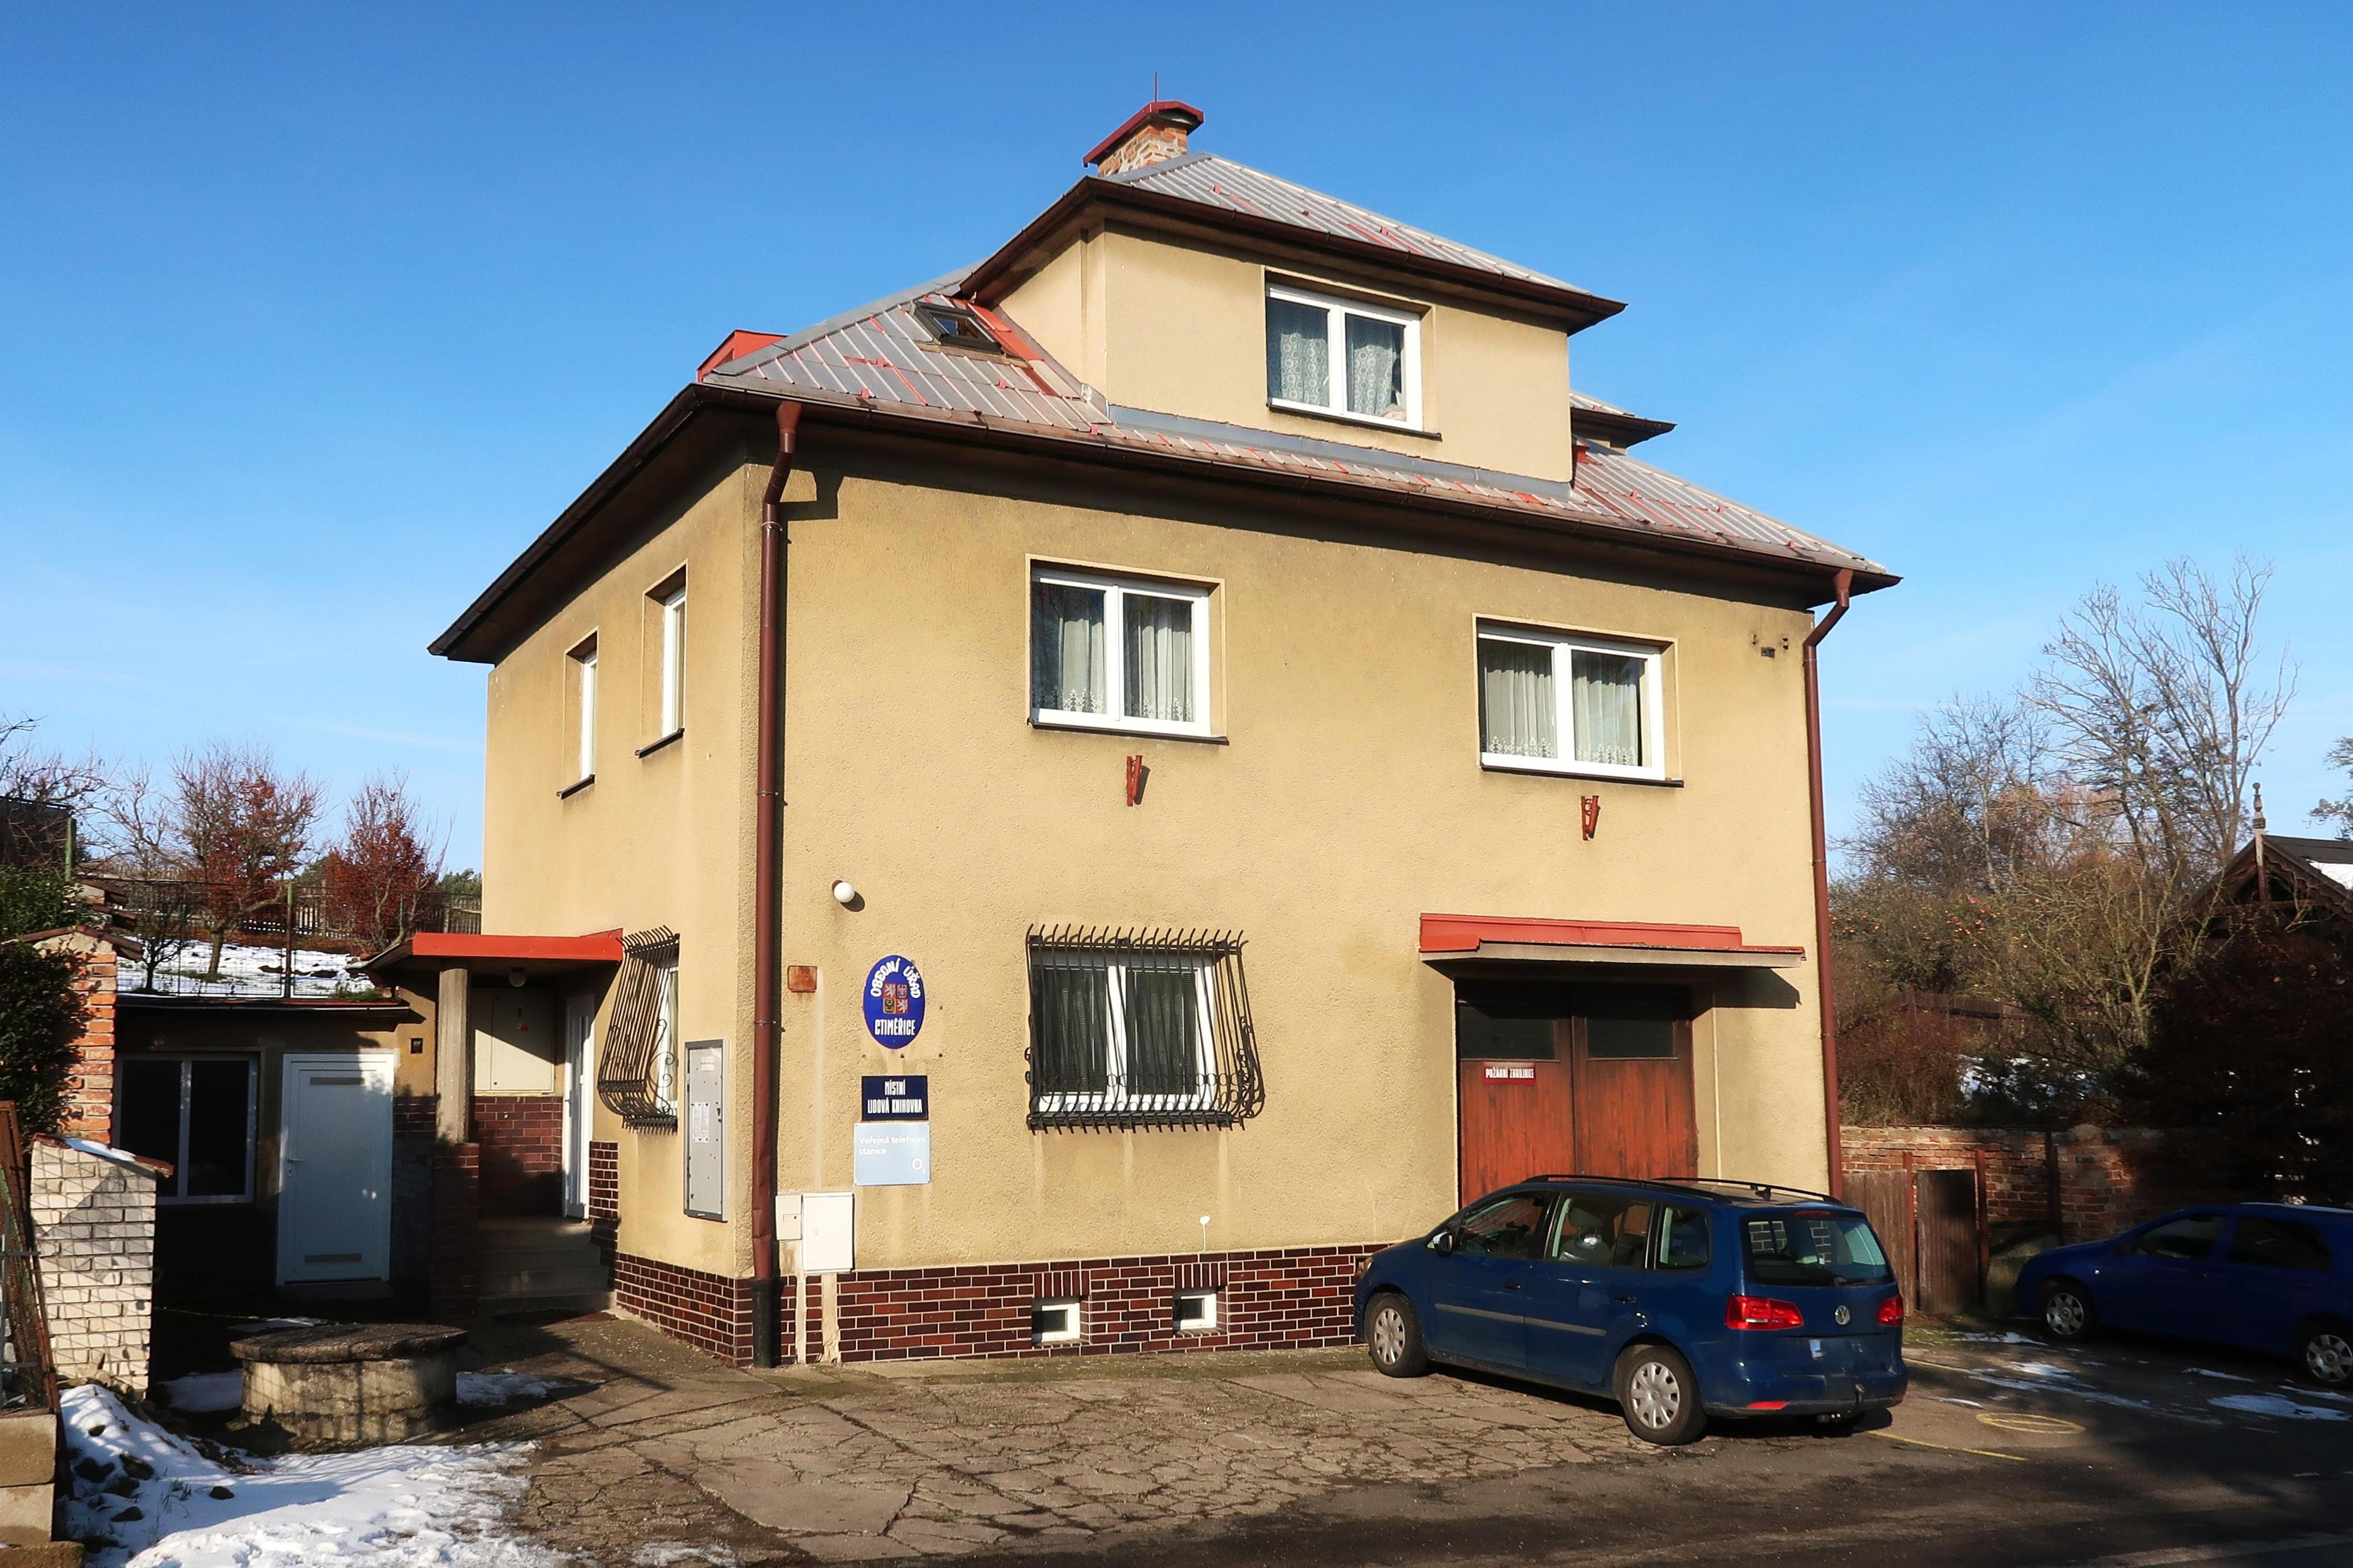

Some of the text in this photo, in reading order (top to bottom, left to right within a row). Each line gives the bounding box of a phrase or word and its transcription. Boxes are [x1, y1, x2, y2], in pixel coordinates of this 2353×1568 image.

[871, 958, 921, 998] OBECNÍ ÚŘAD
[875, 1018, 915, 1035] CTIMĚŘICE
[1485, 1066, 1508, 1078] POŽÁRNÍ
[885, 1079, 905, 1095] MÍSTNÍ
[868, 1097, 922, 1113] LIDOVÁ KNIHOVNA
[859, 1135, 925, 1145] Veřejná telefonní
